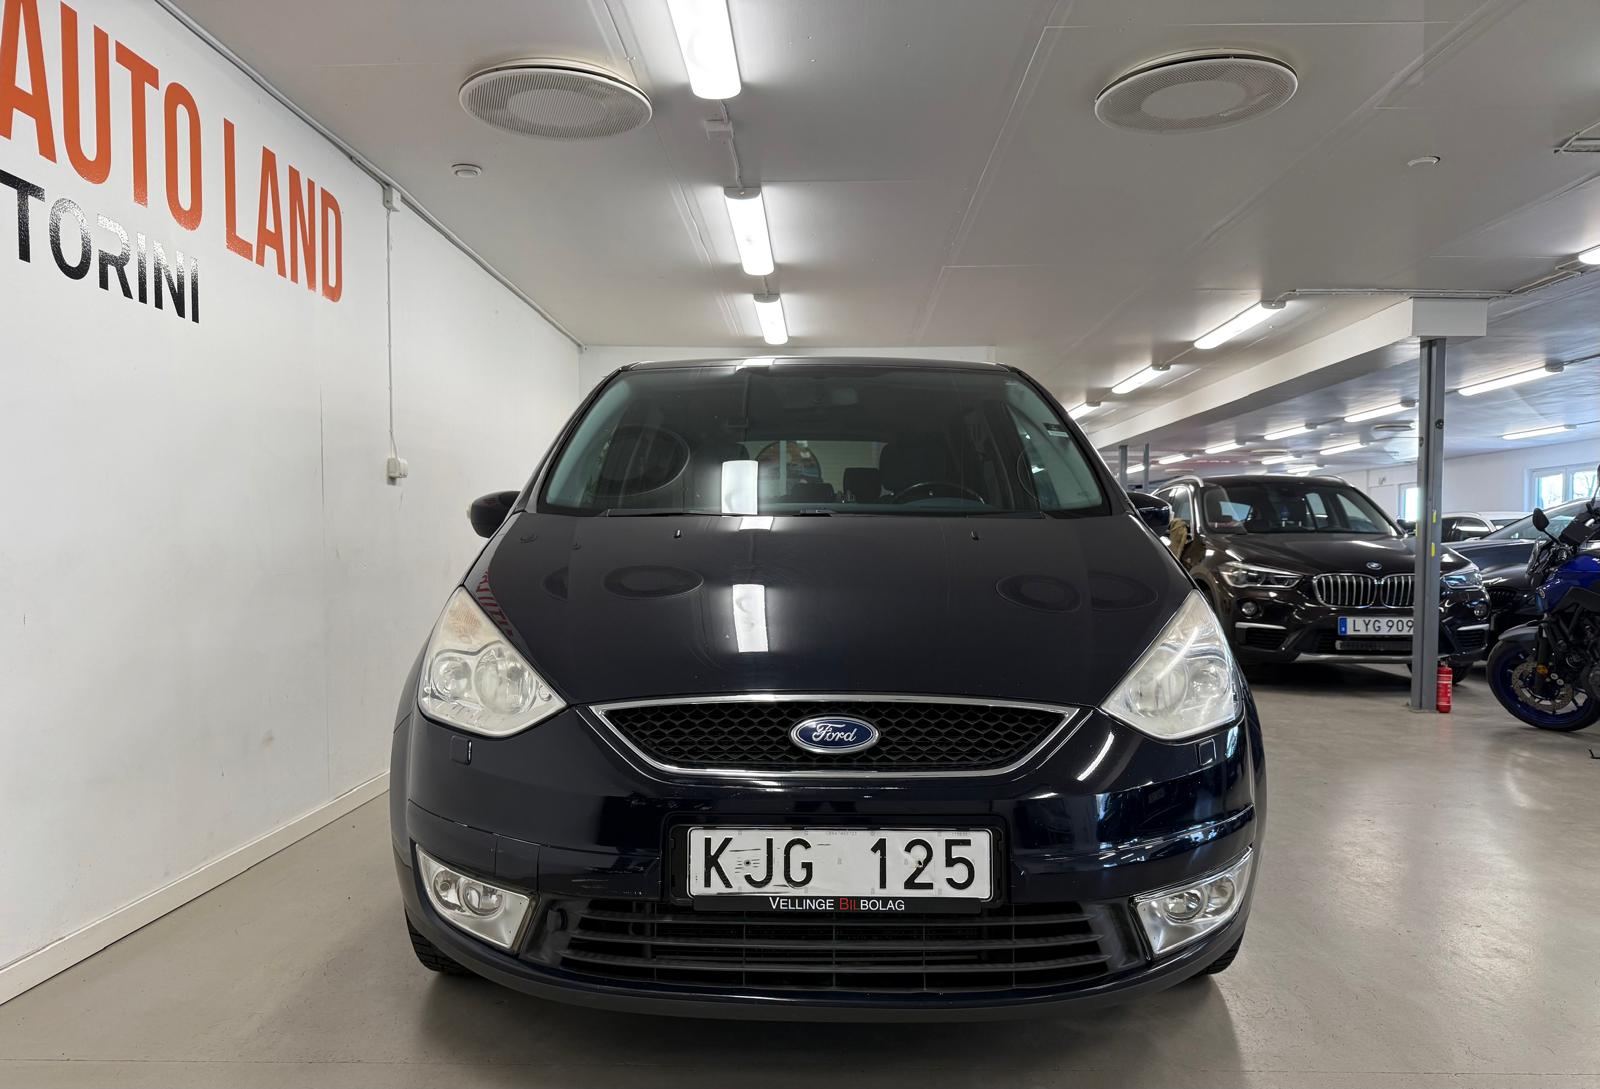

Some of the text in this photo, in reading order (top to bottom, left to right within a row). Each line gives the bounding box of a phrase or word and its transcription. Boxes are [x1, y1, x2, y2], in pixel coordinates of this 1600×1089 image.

[0, 0, 343, 303] AUTO LAND
[0, 169, 200, 324] TORINI
[1353, 619, 1382, 632] LYG
[1386, 619, 1414, 632] 909
[812, 723, 858, 742] Ford
[704, 837, 975, 890] KJG 125
[769, 897, 835, 910] VELLINGE
